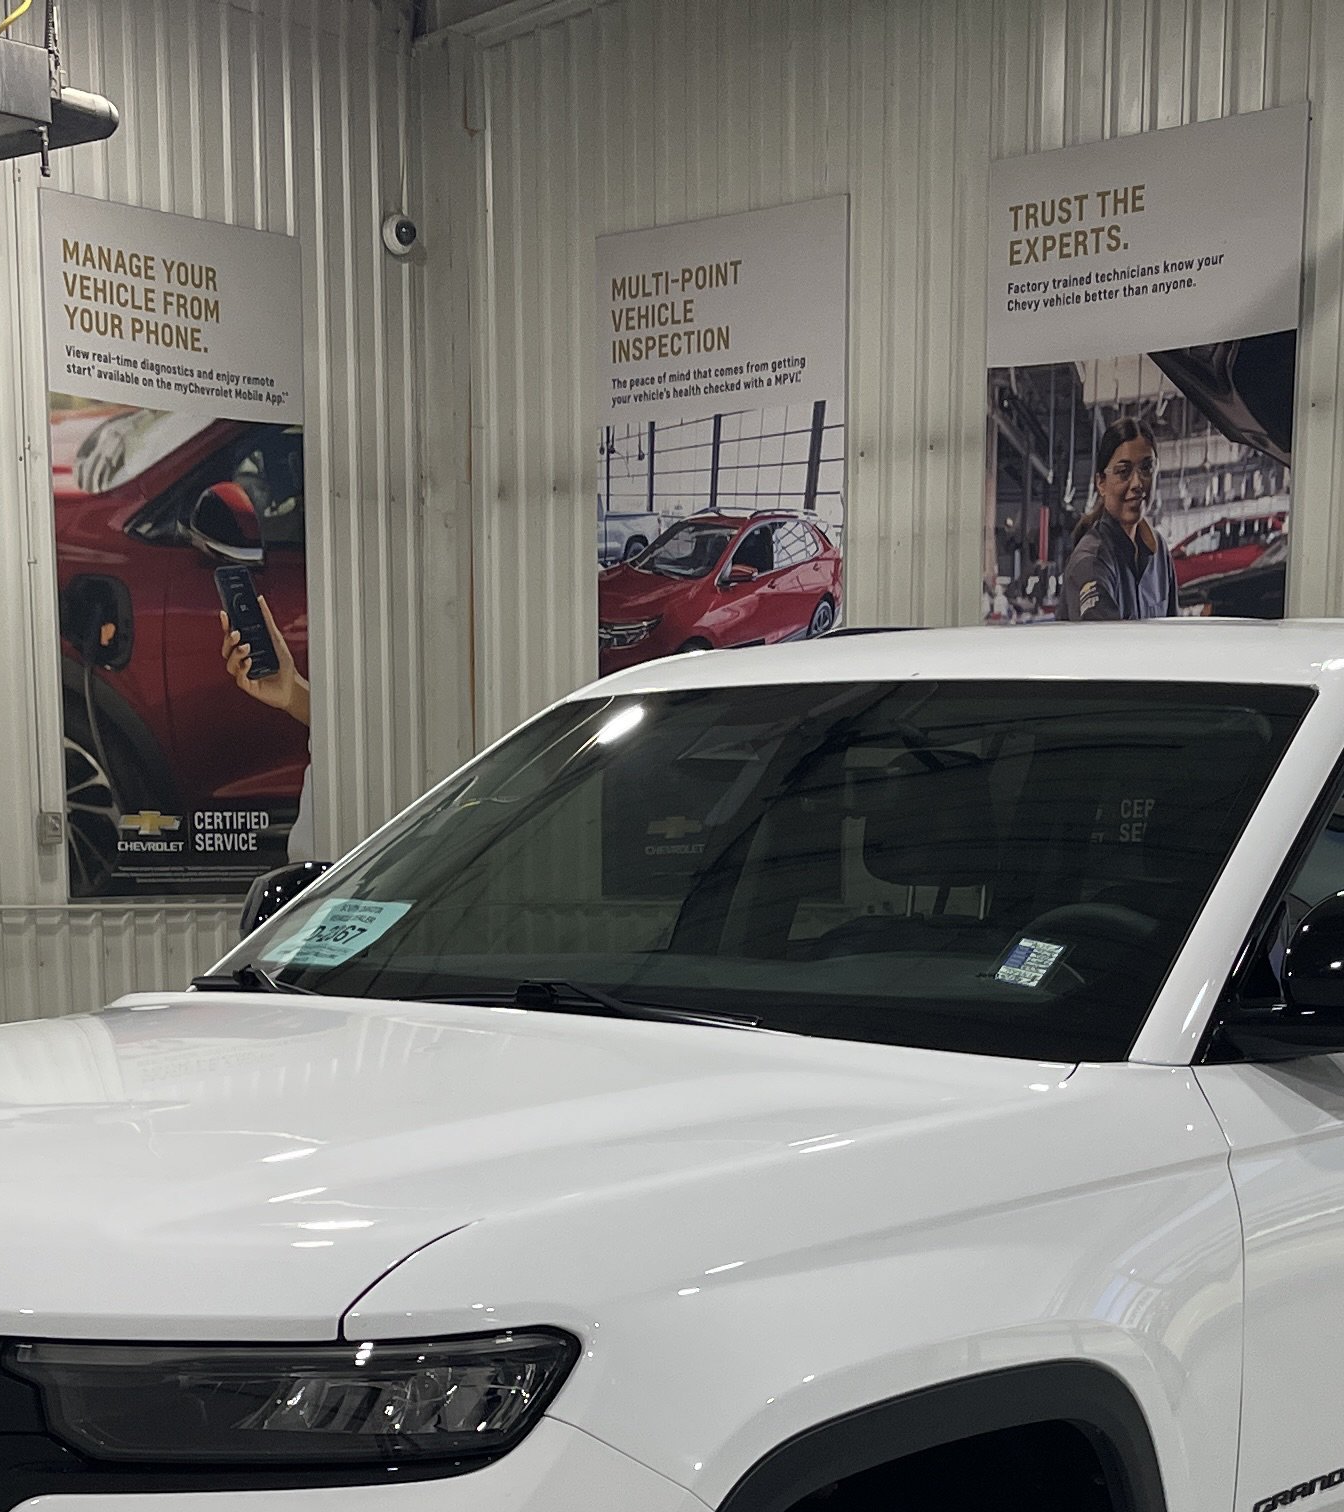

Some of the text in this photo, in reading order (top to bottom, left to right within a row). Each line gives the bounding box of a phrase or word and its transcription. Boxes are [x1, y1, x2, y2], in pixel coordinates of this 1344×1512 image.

[1009, 183, 1145, 232] TRUST THE
[1009, 224, 1129, 266] EXPERTS.
[62, 238, 218, 292] MANAGE YOUR
[611, 259, 742, 301] MULTI-POINT
[1007, 253, 1224, 295] Factory trained technicians know your
[62, 271, 220, 323] VEHICLE FROM
[1007, 277, 1197, 313] Chevy vehicle better than anyone.
[63, 304, 209, 353] YOUR PHONE.
[611, 299, 695, 333] VEHICLE
[612, 325, 730, 364] INSPECTION
[65, 344, 275, 388] View real-time diagnostics and enjoy remote
[97, 368, 139, 385] available
[142, 377, 154, 388] on
[156, 377, 172, 390] the
[174, 378, 233, 399] myChevrolet
[234, 387, 263, 402] Mobile
[611, 355, 806, 391] The peace of mind that comes from getting
[611, 393, 632, 408] your
[633, 388, 671, 403] vehicle's
[672, 384, 702, 399] health
[703, 380, 741, 395] checked
[743, 377, 765, 390] with
[766, 377, 773, 387] a
[194, 811, 269, 830] CERTIFIED
[117, 840, 184, 852] CHEVROLET
[194, 832, 258, 851] SERVICE
